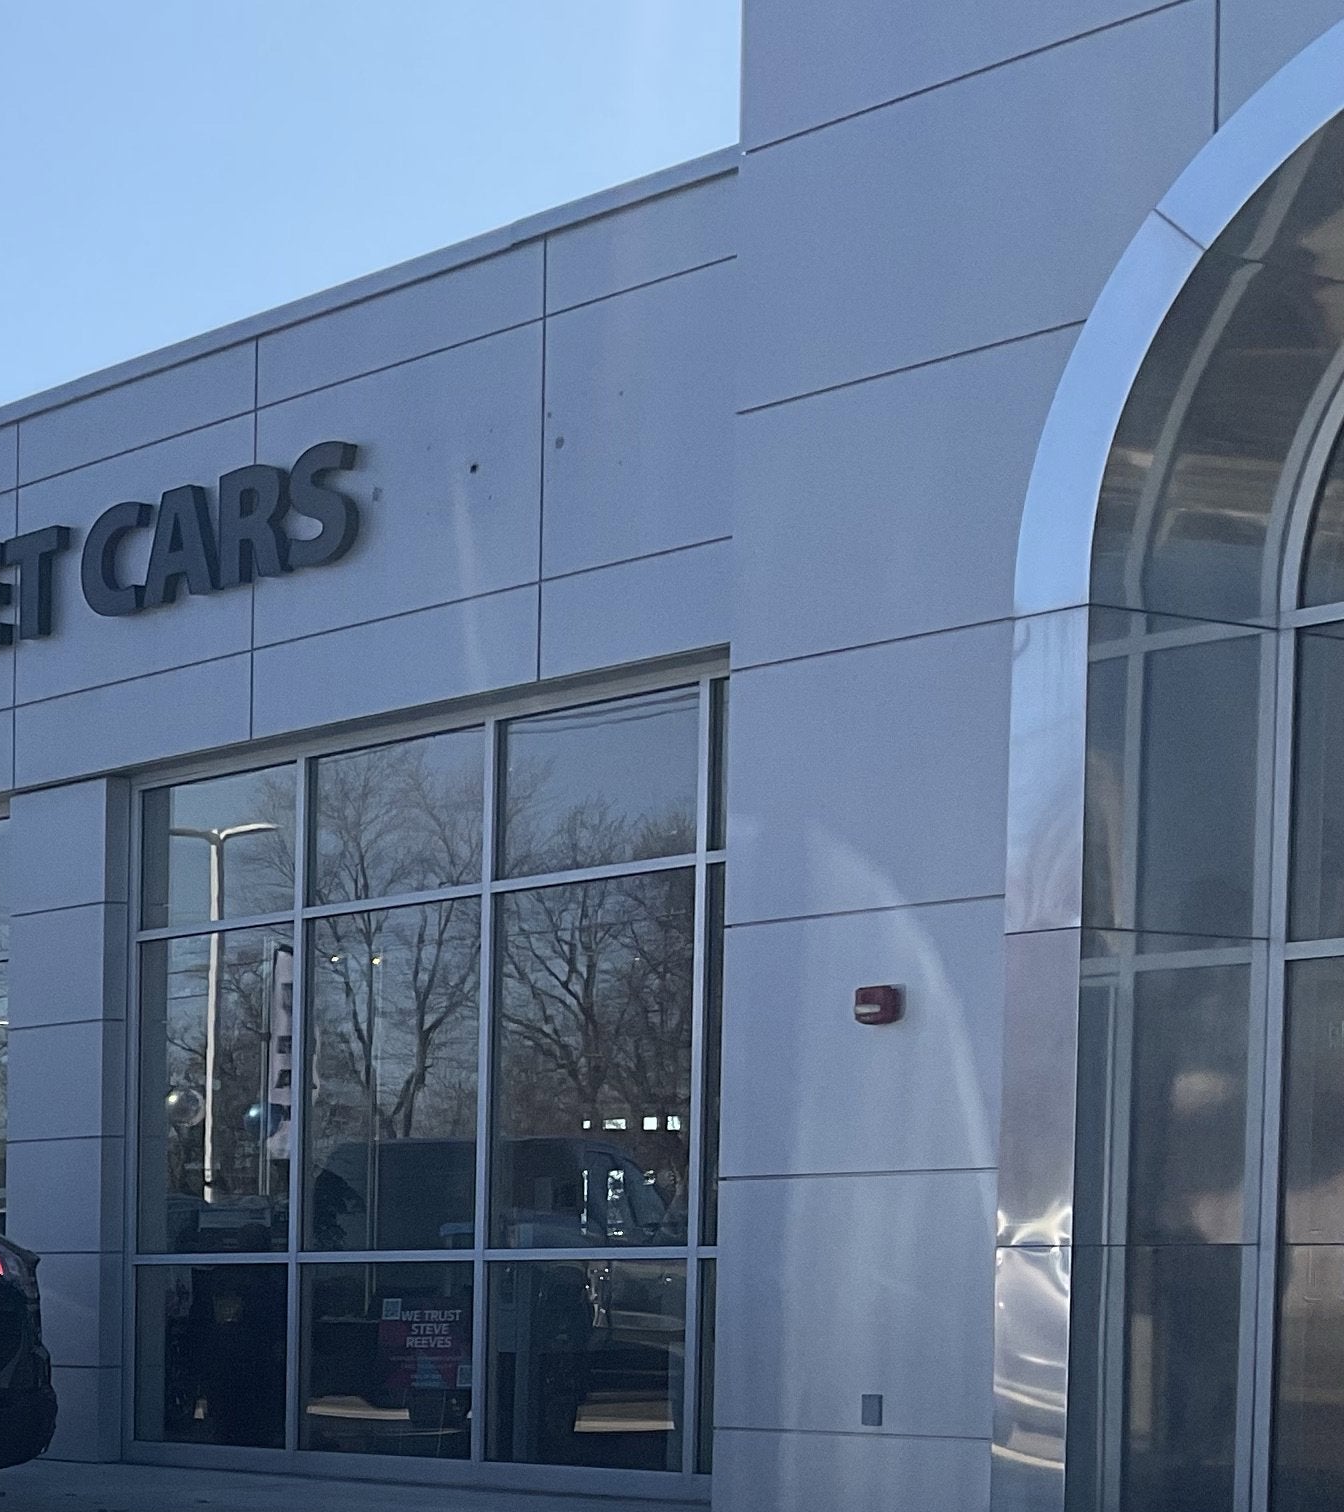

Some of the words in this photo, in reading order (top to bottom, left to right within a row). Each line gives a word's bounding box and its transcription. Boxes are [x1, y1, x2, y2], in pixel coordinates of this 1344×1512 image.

[81, 440, 359, 618] CARS
[401, 1310, 421, 1321] WE
[424, 1309, 462, 1321] TRUST
[411, 1323, 450, 1335] STEVE
[406, 1336, 452, 1348] REEVES
